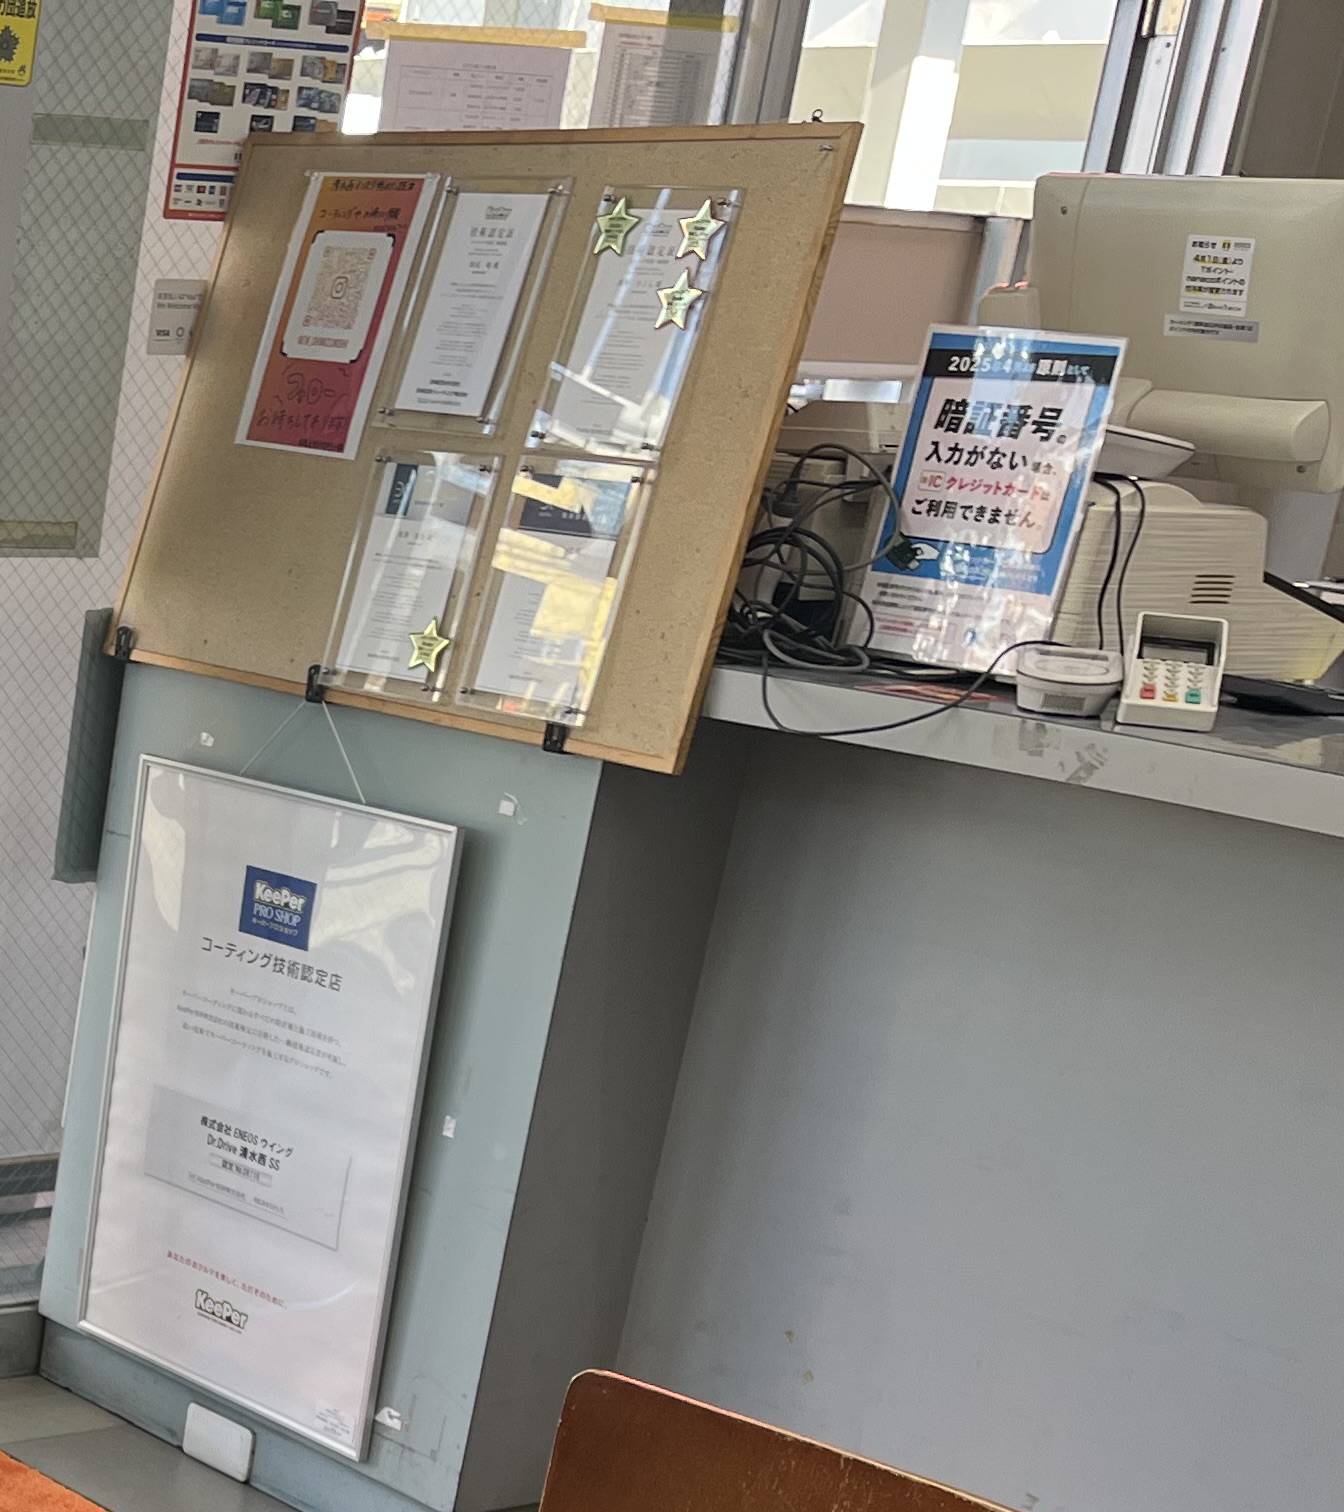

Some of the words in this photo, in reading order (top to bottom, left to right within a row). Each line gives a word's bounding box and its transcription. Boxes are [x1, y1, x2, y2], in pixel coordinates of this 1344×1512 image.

[252, 902, 273, 920] PRO
[274, 908, 301, 927] SHOP
[253, 878, 307, 913] KeePer
[200, 935, 343, 992] コーティング技術認定店
[200, 1115, 232, 1136] 株式会社
[233, 1127, 258, 1146] ENEOS
[260, 1137, 293, 1159] ウイング
[206, 1133, 237, 1156] Dr.Drive
[268, 1157, 280, 1171] SS
[194, 1287, 249, 1331] KeePer
